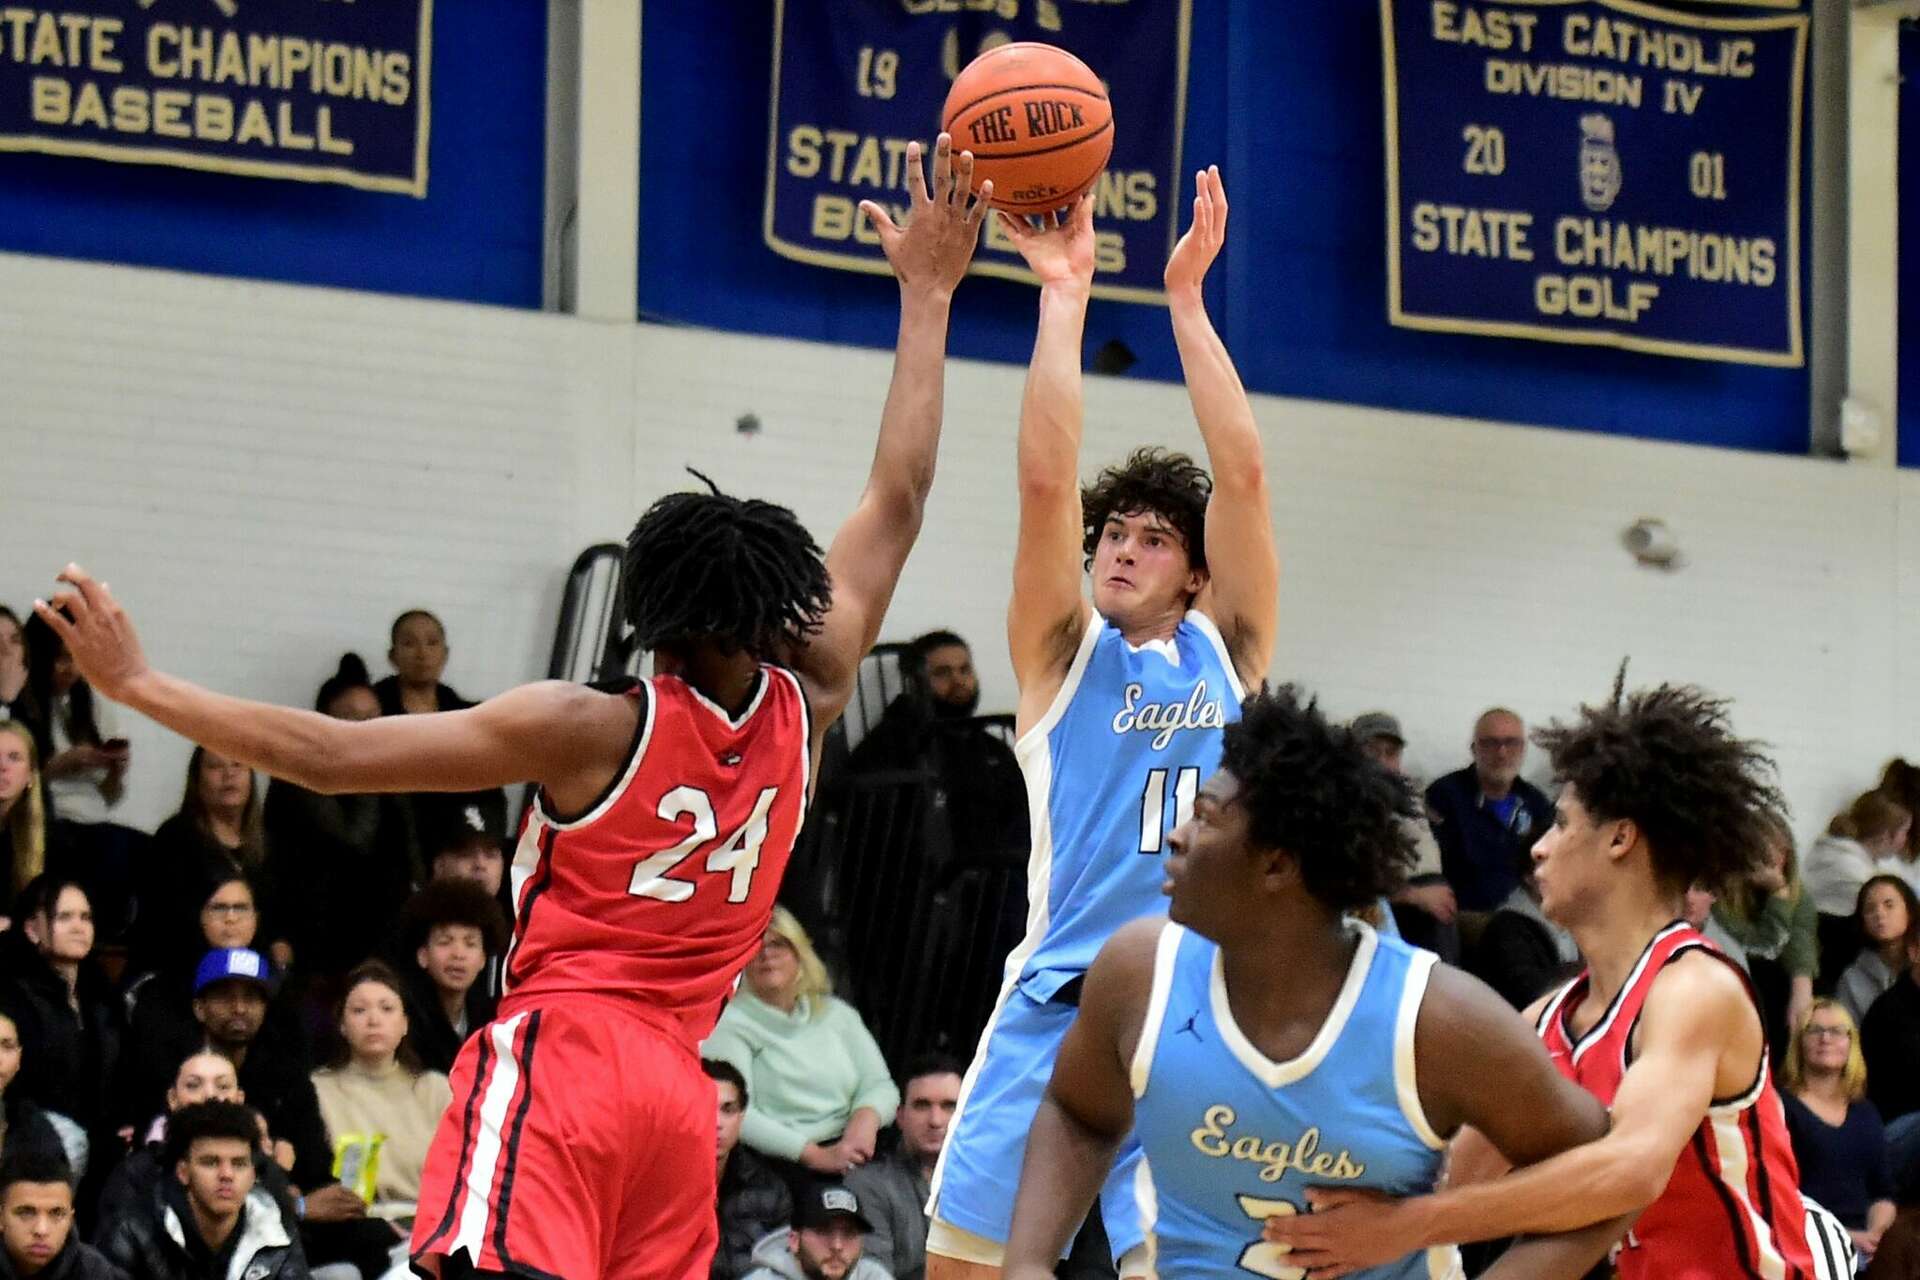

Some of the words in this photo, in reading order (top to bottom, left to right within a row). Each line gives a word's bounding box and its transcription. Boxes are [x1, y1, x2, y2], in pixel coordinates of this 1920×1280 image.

[0, 9, 124, 73] TATE
[147, 23, 411, 106] CHAMPIONS
[856, 46, 899, 100] 19
[1432, 1, 1537, 52] EAST
[1564, 14, 1755, 78] CATHOLIC
[32, 77, 354, 155] BASEBALL
[968, 105, 1016, 144] THE
[1023, 100, 1084, 138] ROCK
[1485, 59, 1642, 108] DIVISION
[1662, 79, 1704, 115] IV
[1012, 186, 1059, 201] ROCK
[1462, 124, 1506, 176] 20
[1689, 151, 1726, 200] 01
[1411, 203, 1535, 263] STATE
[1555, 216, 1777, 287] CHAMPIONS
[1534, 274, 1660, 322] GOLF
[1112, 680, 1225, 750] Eagles
[628, 784, 780, 904] 24
[1138, 767, 1200, 854] 11
[1190, 1104, 1365, 1182] Eagles
